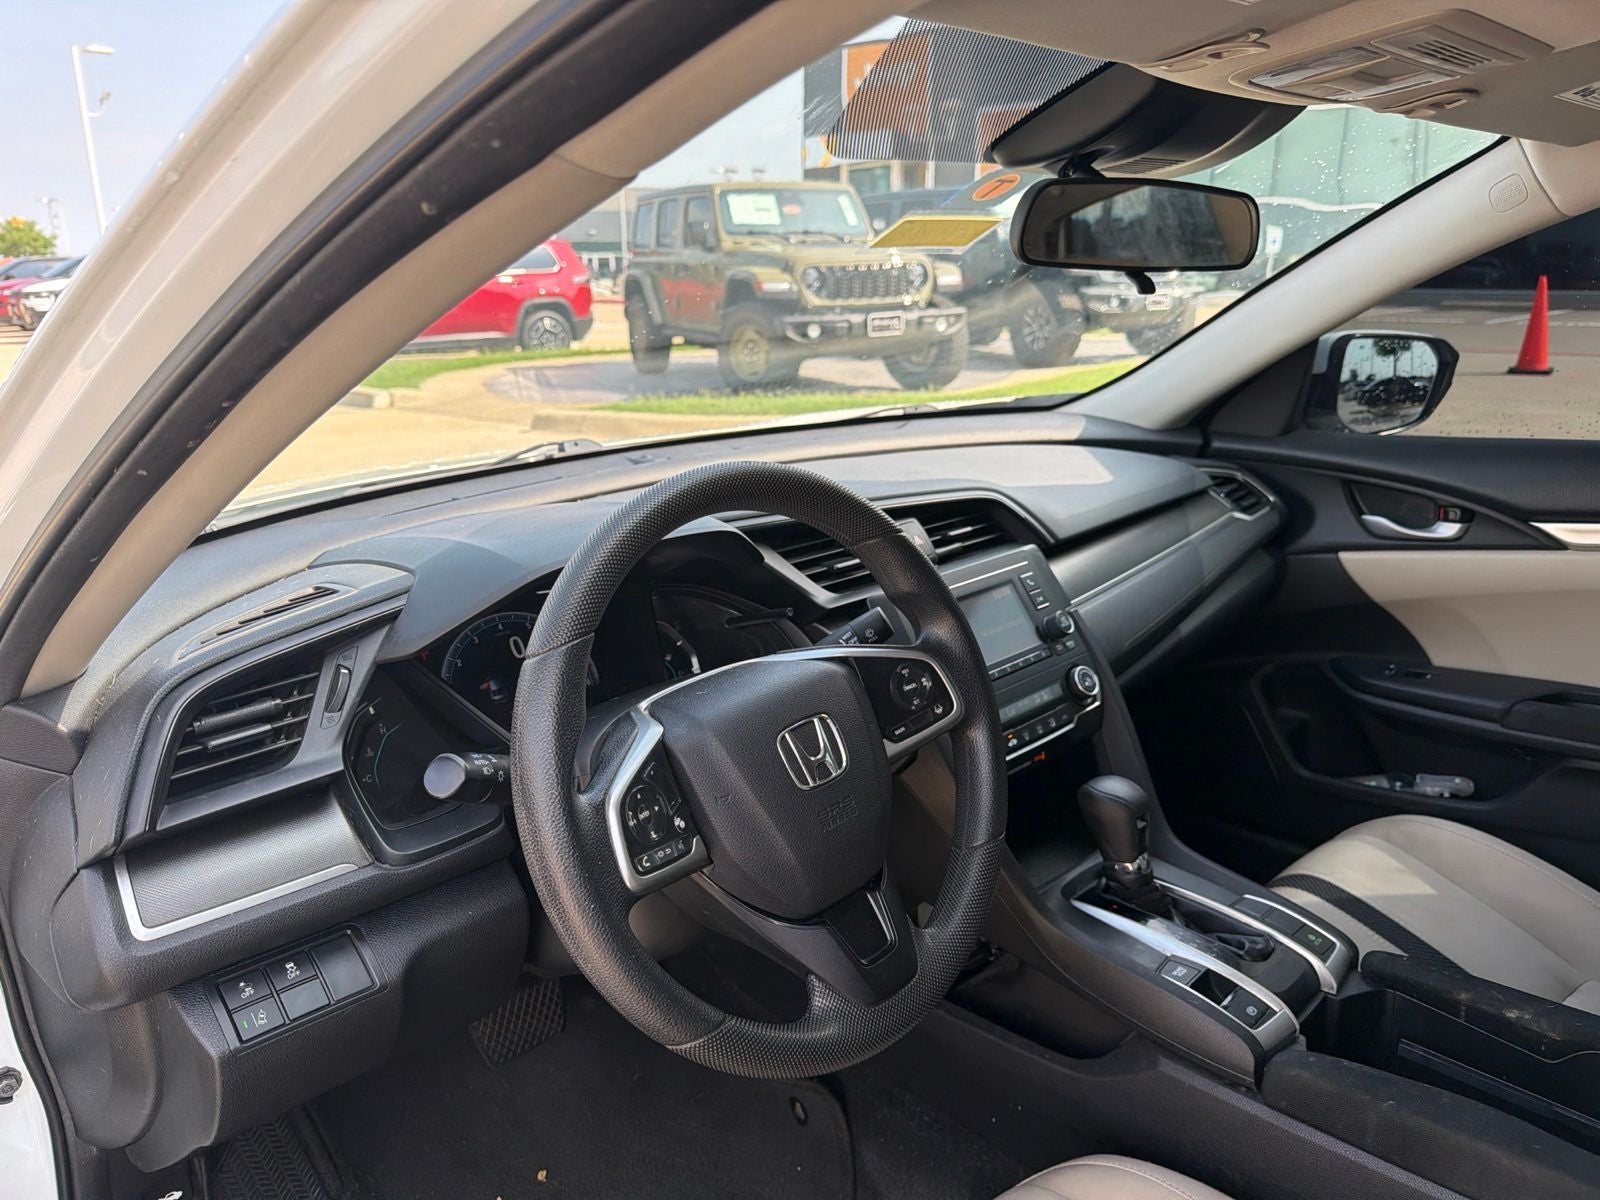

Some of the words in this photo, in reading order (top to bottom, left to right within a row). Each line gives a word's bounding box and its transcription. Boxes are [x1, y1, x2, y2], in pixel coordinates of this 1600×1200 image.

[509, 636, 526, 659] 0
[287, 970, 300, 980] OFF
[241, 989, 255, 999] OFF
